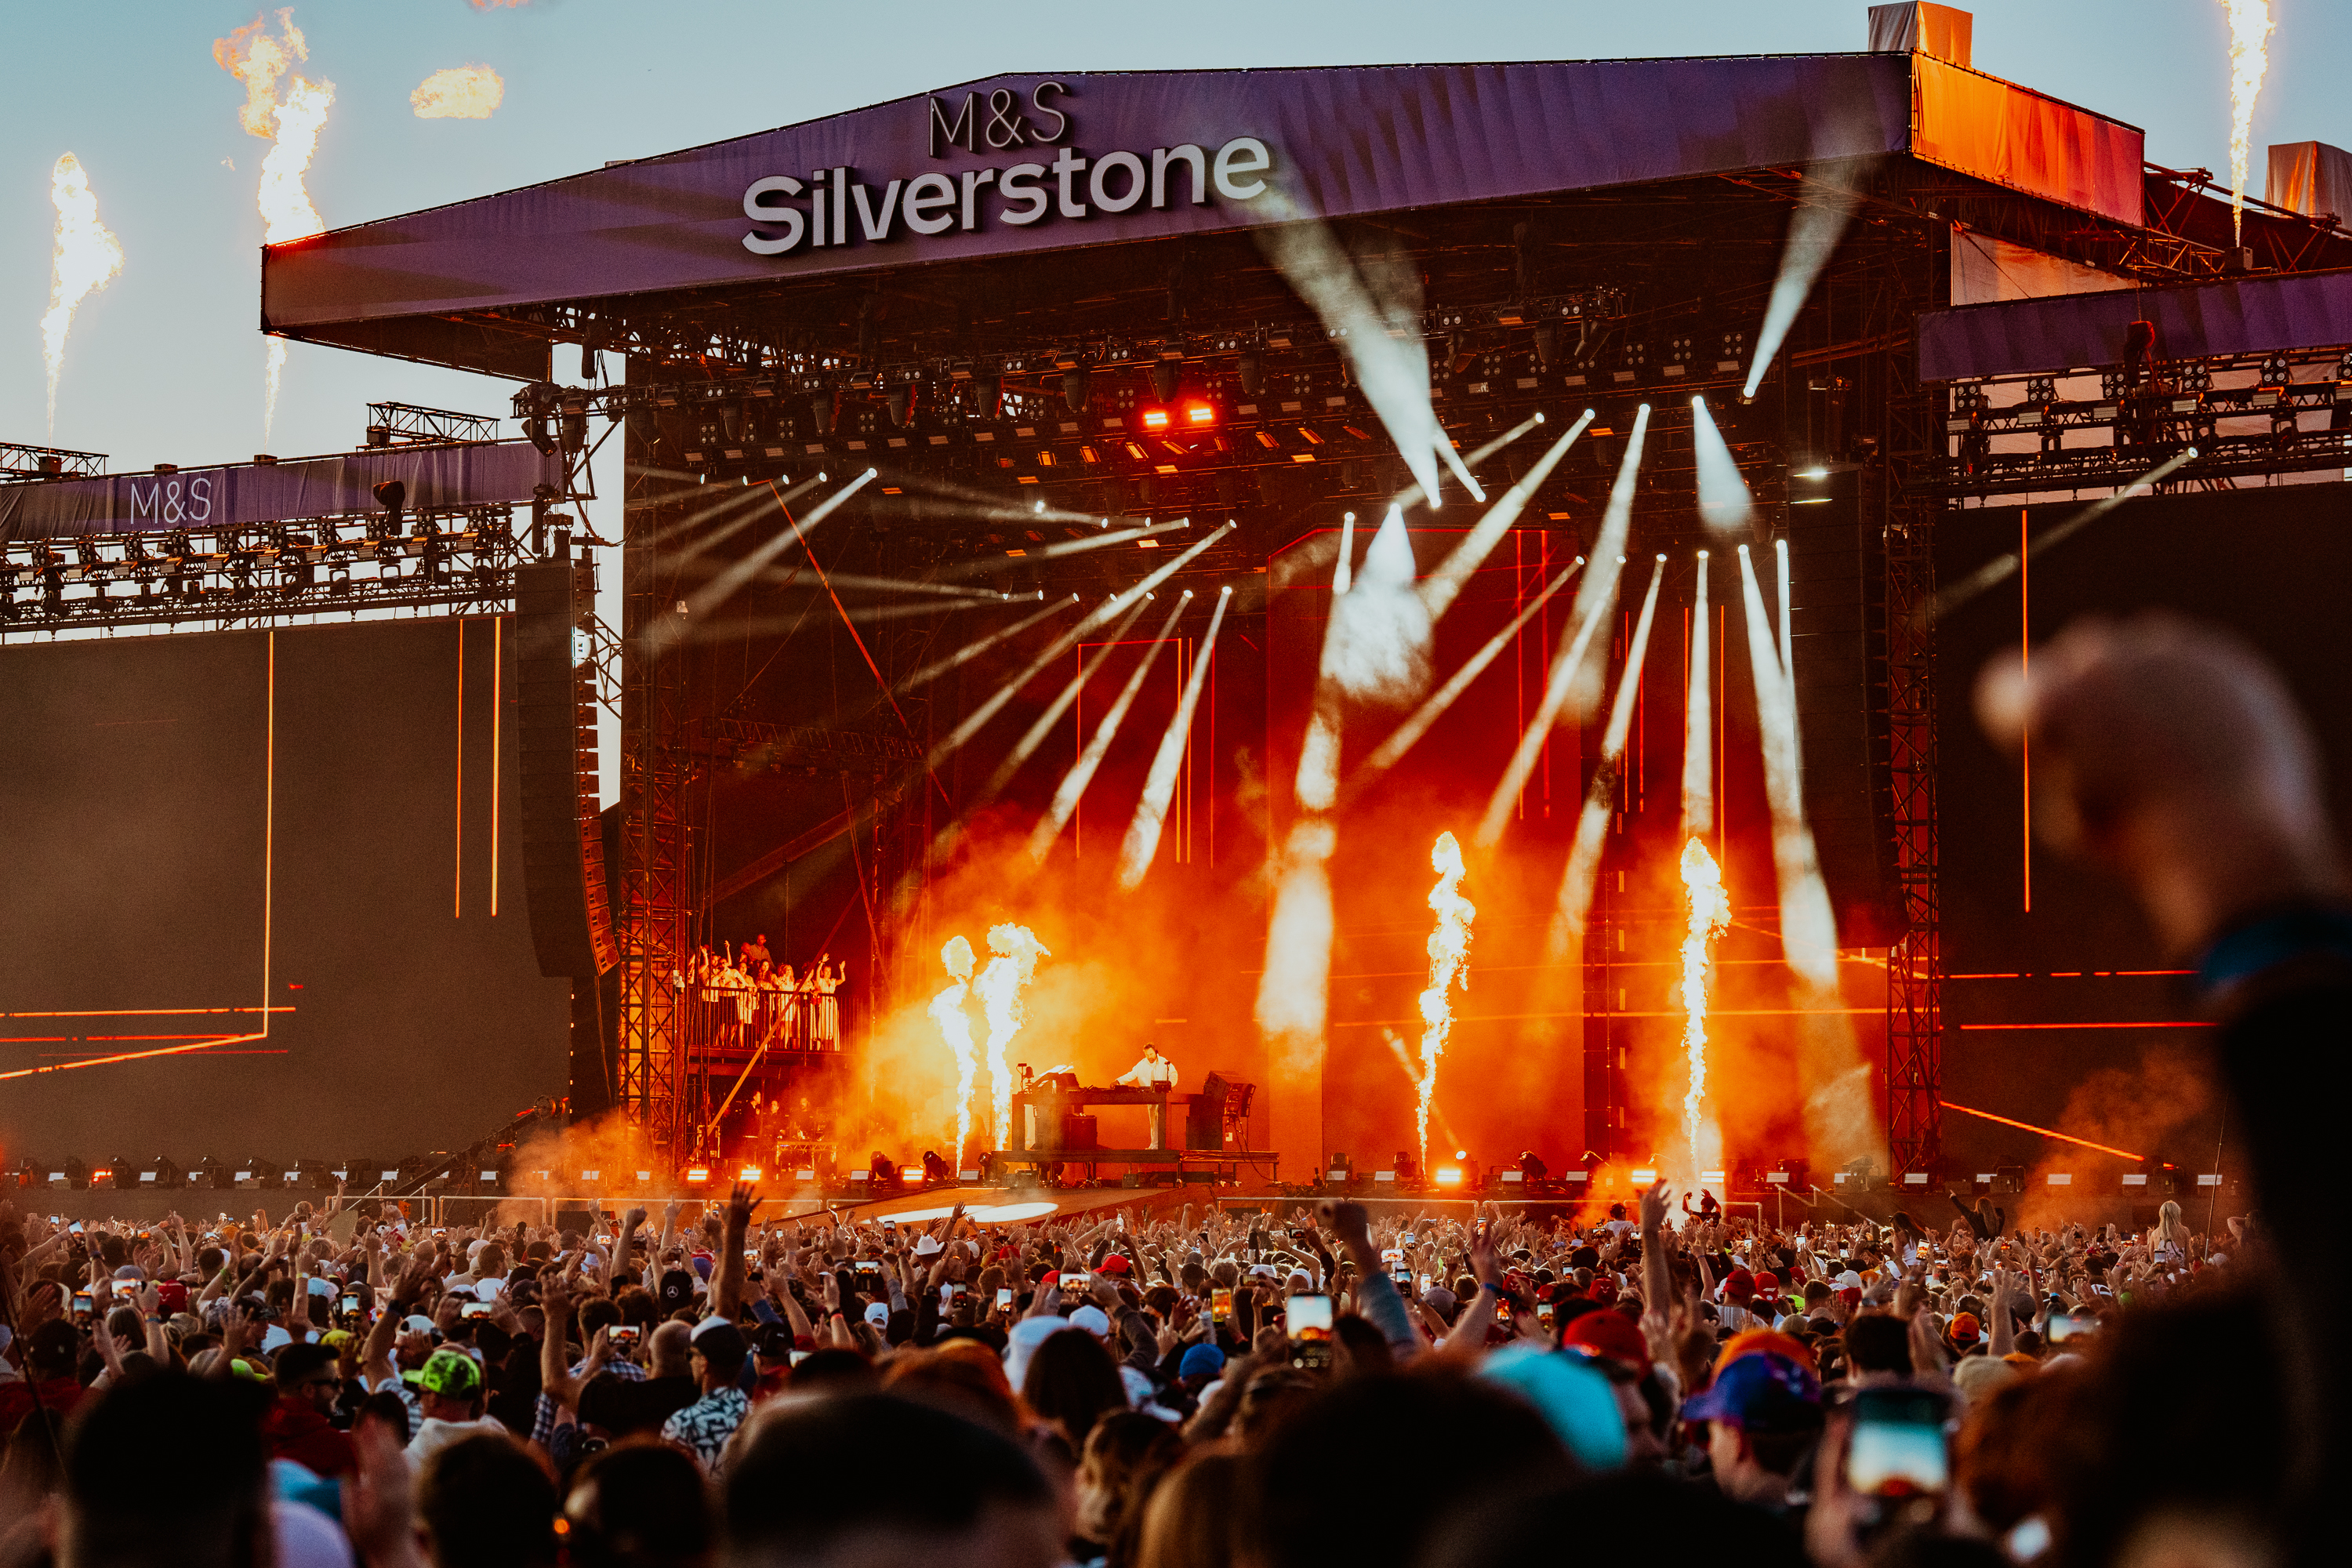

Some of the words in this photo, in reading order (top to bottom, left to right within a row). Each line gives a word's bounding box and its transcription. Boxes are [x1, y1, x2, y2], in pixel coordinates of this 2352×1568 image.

[929, 81, 1065, 157] M&S
[741, 136, 1269, 255] Silverstone
[130, 477, 211, 524] M&S
